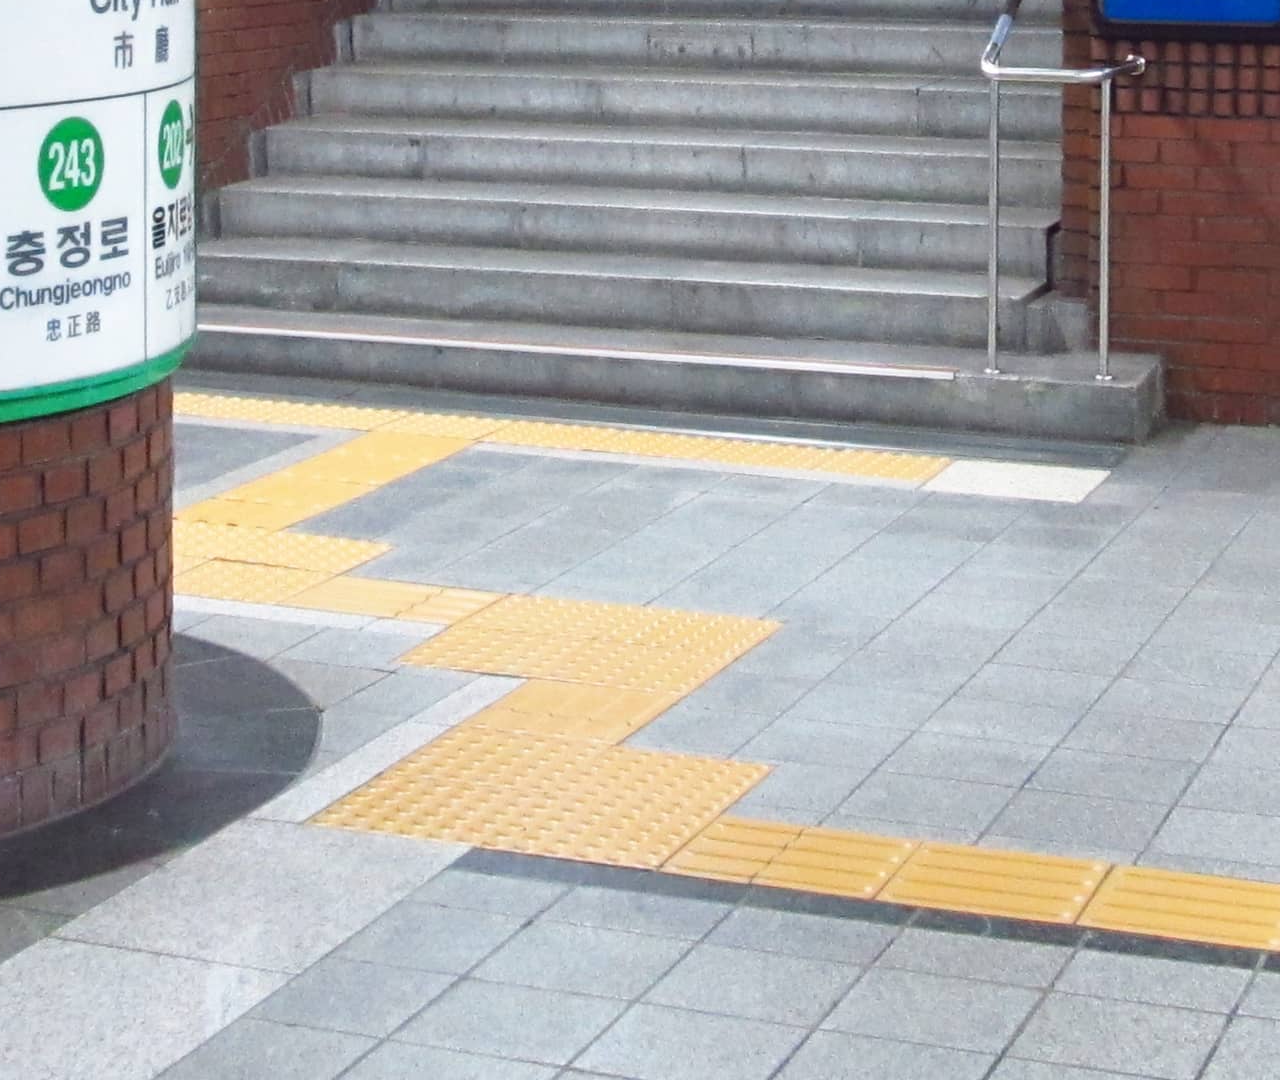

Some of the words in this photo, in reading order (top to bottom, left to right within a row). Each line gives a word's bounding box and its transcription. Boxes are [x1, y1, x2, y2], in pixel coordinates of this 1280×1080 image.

[47, 138, 96, 191] 243
[162, 120, 184, 171] 202
[4, 216, 129, 277] 충정로
[152, 192, 194, 250] 을지로
[46, 310, 101, 342] 忠正路
